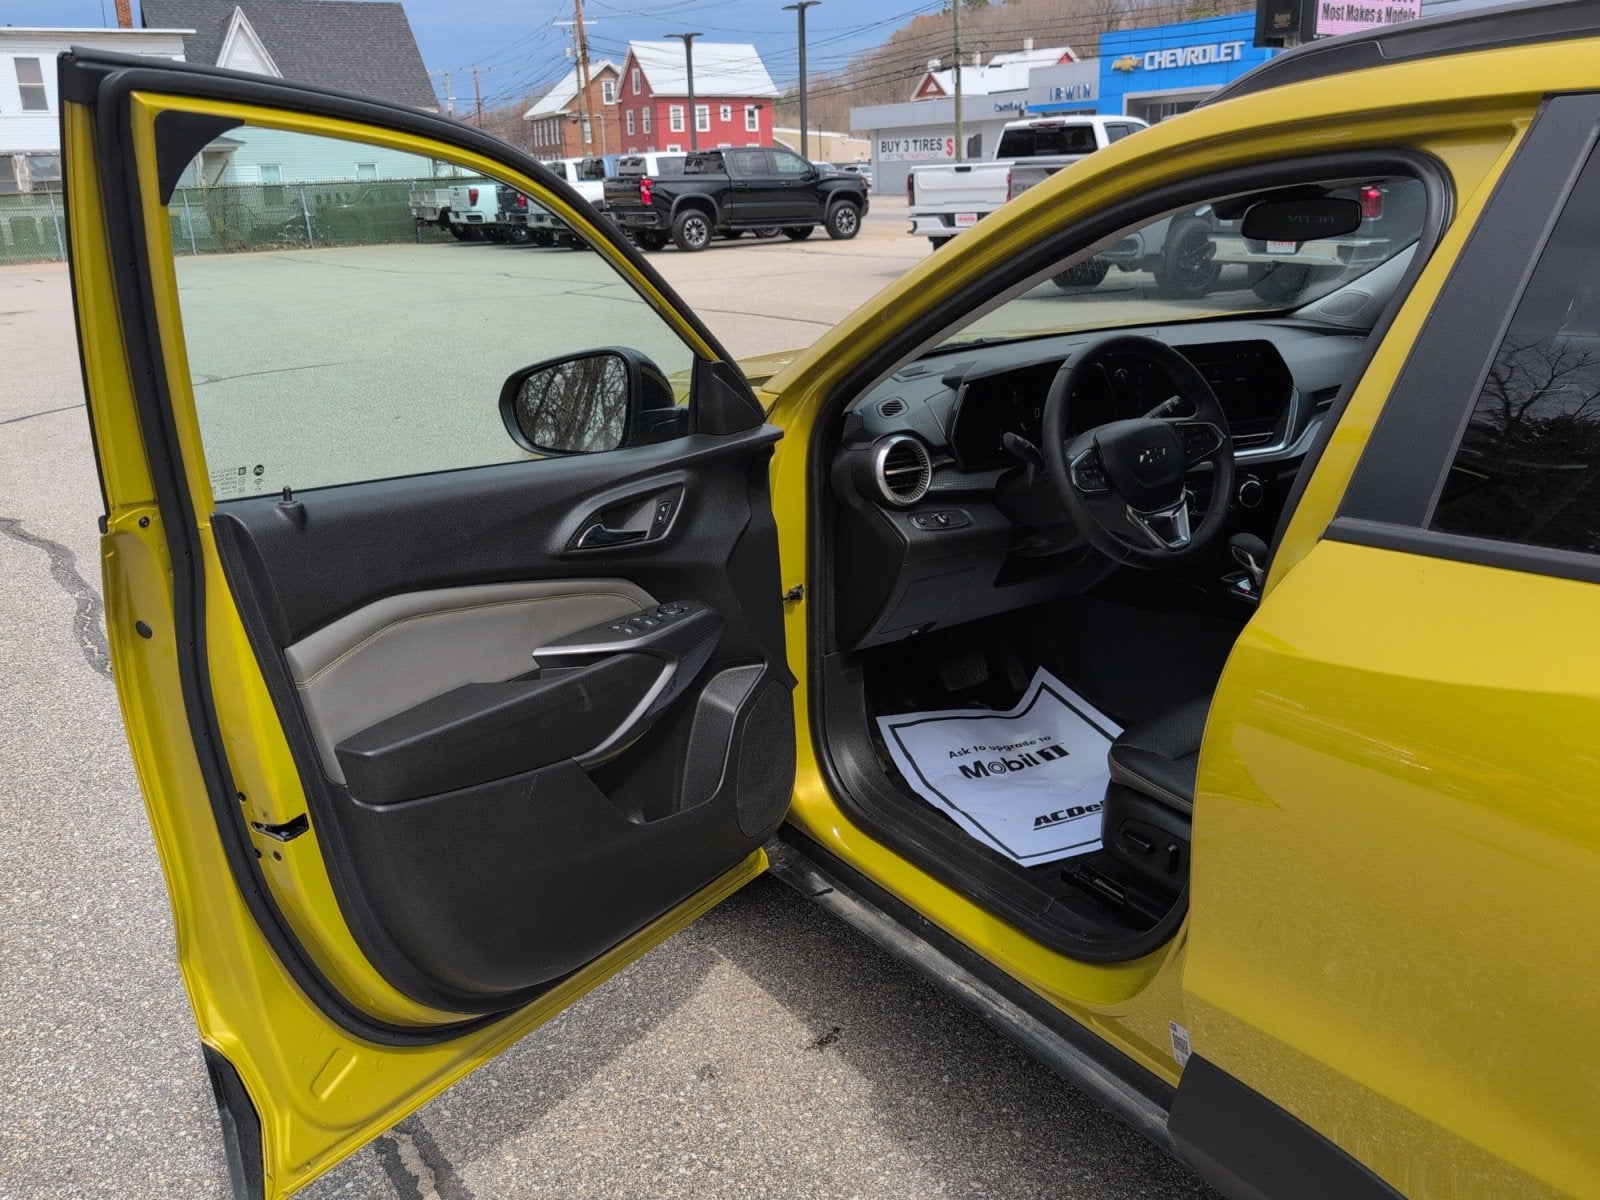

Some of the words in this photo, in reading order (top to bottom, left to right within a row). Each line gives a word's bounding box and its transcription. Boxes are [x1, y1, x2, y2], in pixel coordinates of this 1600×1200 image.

[1322, 3, 1344, 21] Most
[1346, 4, 1375, 22] Makes
[1377, 8, 1383, 23] &
[1385, 7, 1416, 23] Models
[1143, 41, 1245, 71] CHEVROLET
[1049, 84, 1091, 101] IRWIN
[881, 141, 900, 153] BUY
[904, 140, 909, 152] 3
[912, 138, 942, 152] TIRES
[949, 747, 971, 759] Ask
[973, 745, 986, 753] to
[988, 740, 1037, 753] upgrade
[958, 752, 1041, 779] Mobil
